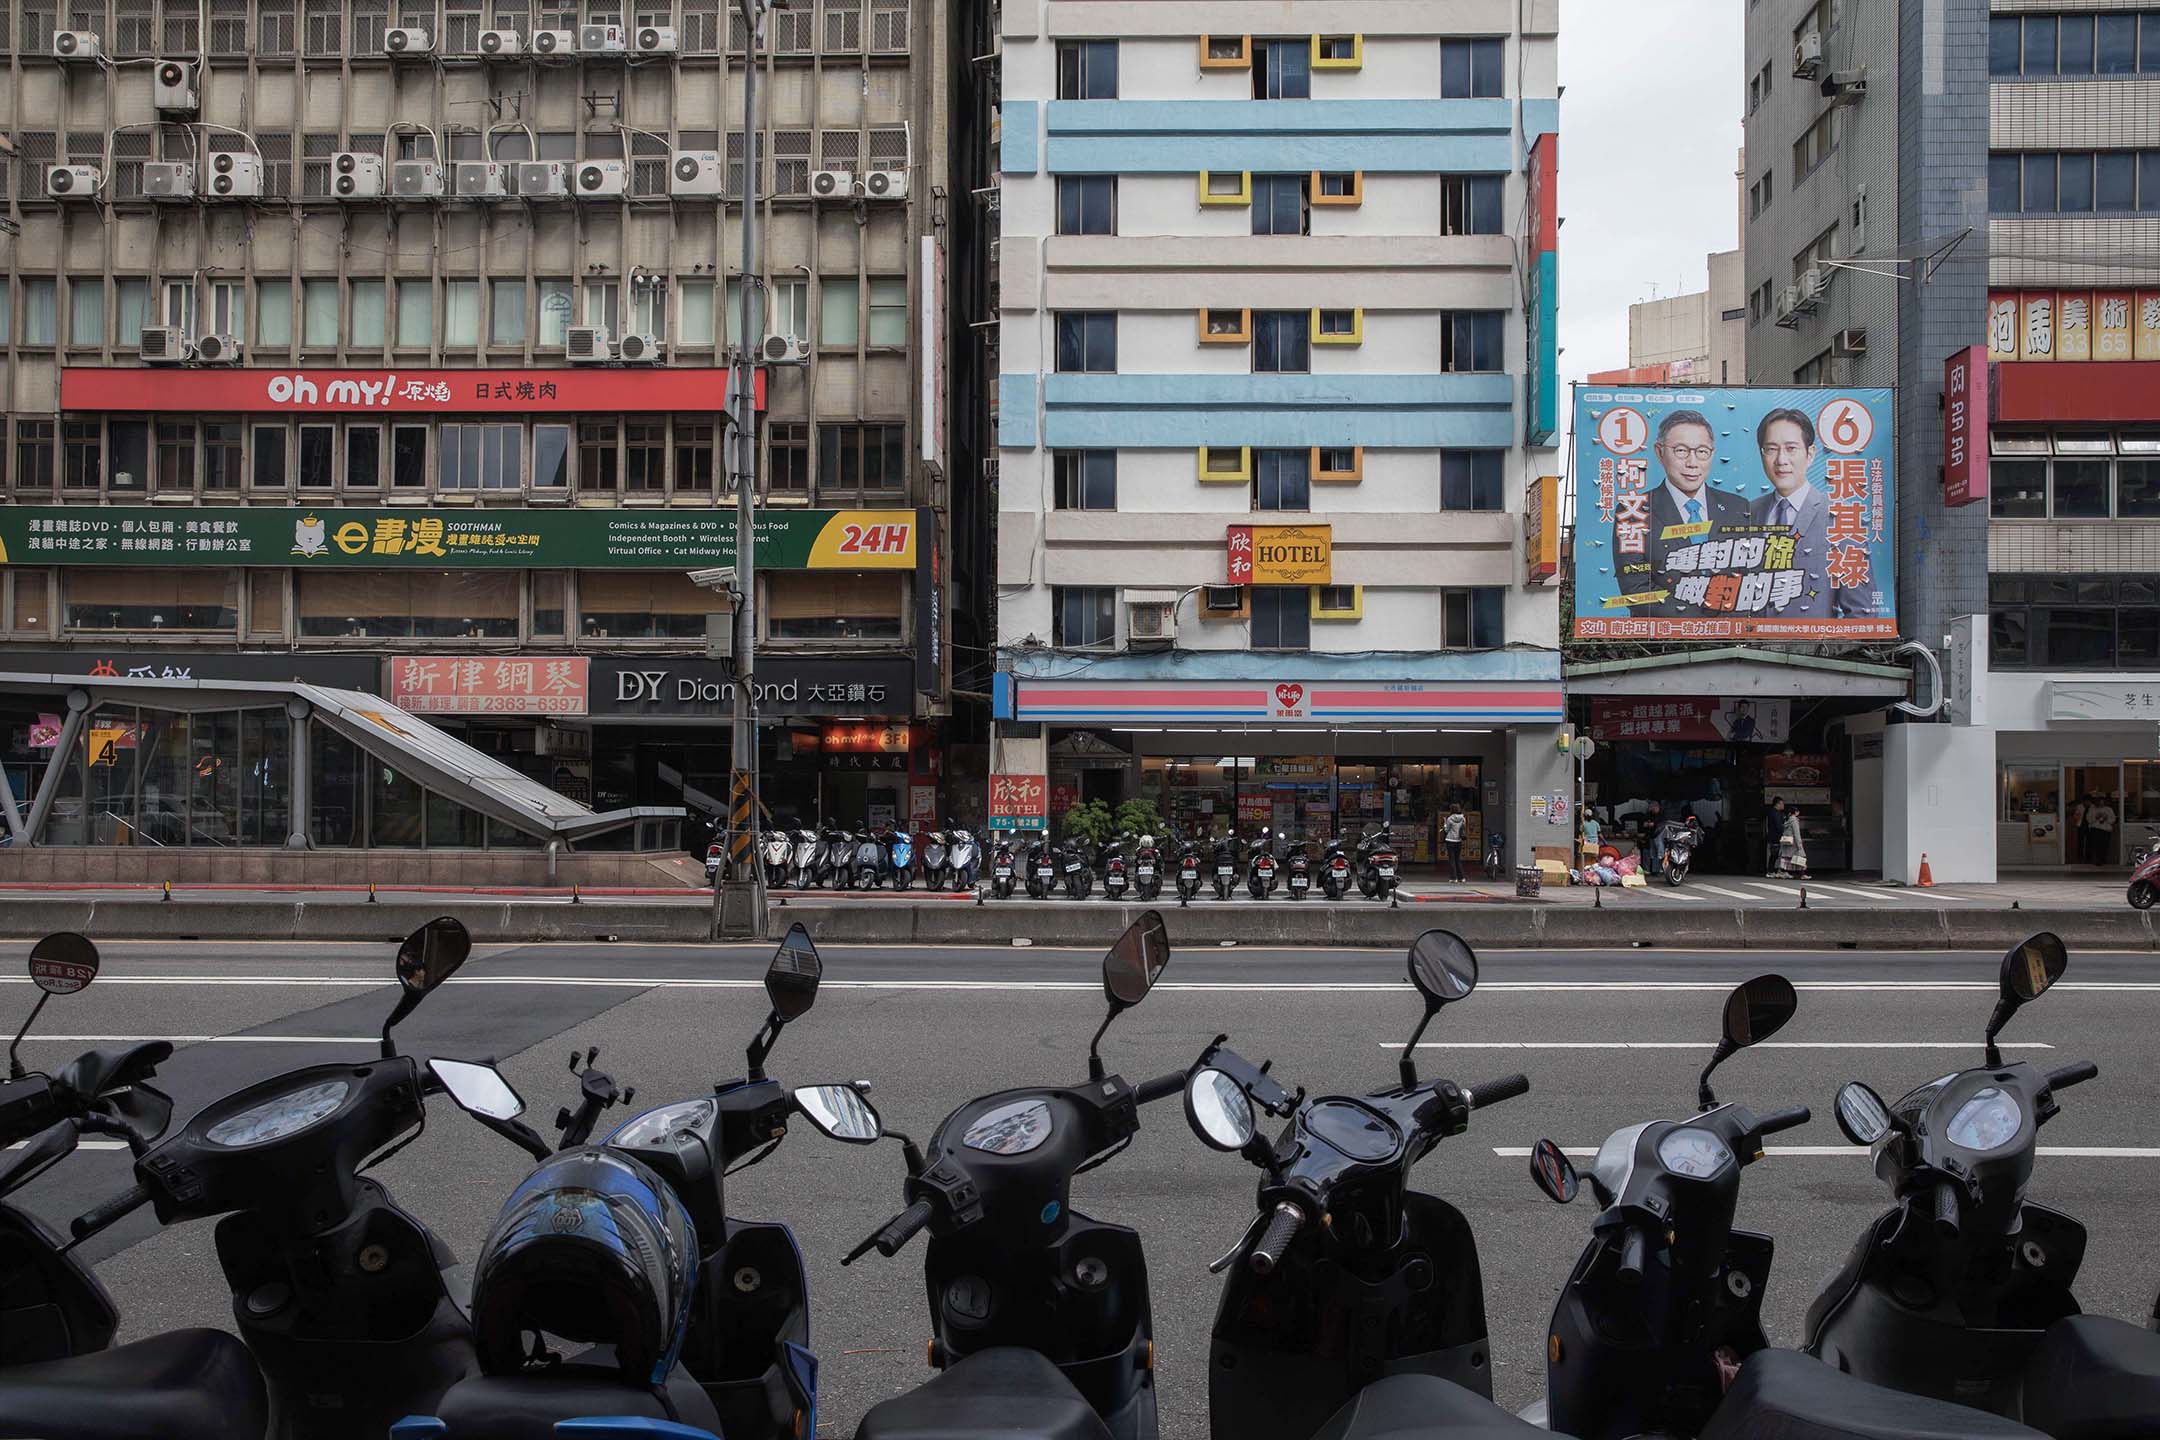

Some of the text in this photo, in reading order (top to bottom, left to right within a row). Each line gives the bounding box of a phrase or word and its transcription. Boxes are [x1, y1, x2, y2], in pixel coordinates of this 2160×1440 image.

[2063, 333, 2088, 353] 33
[2102, 333, 2127, 353] 65
[1615, 417, 1632, 445] 1
[1832, 406, 1859, 446] 6
[1599, 457, 1615, 523] 總統候選人
[1871, 458, 1884, 543] 立法委員候選人
[1616, 458, 1649, 555] 柯文哲
[186, 521, 239, 534] 美食餐飲
[447, 522, 502, 532] SOOTHMAN
[608, 522, 639, 530] Comics
[640, 522, 648, 530] &
[649, 522, 691, 531] Magazines
[1825, 459, 1869, 590] 張其祿
[28, 537, 108, 550] 浪貓中途之家
[121, 538, 174, 551] 無線網路
[608, 534, 661, 543] Independent
[608, 547, 636, 555] Virtual
[638, 547, 662, 555] Office
[673, 547, 687, 555] Cat
[689, 547, 721, 556] Midway
[838, 523, 911, 554] 24H
[1231, 532, 1252, 577] 欣和
[1258, 545, 1325, 563] HOTEL
[1674, 569, 1805, 612] 做對的事
[1581, 620, 1606, 634] 文山
[1611, 620, 1648, 634] 南中正
[401, 659, 582, 695] 新律鋼琴
[616, 670, 669, 701] DY
[808, 684, 886, 702] 大亞鑽石
[484, 698, 583, 711] 2363-6397
[99, 740, 117, 767] 4
[993, 778, 1041, 803] 欣和
[993, 804, 1041, 814] HOTEL
